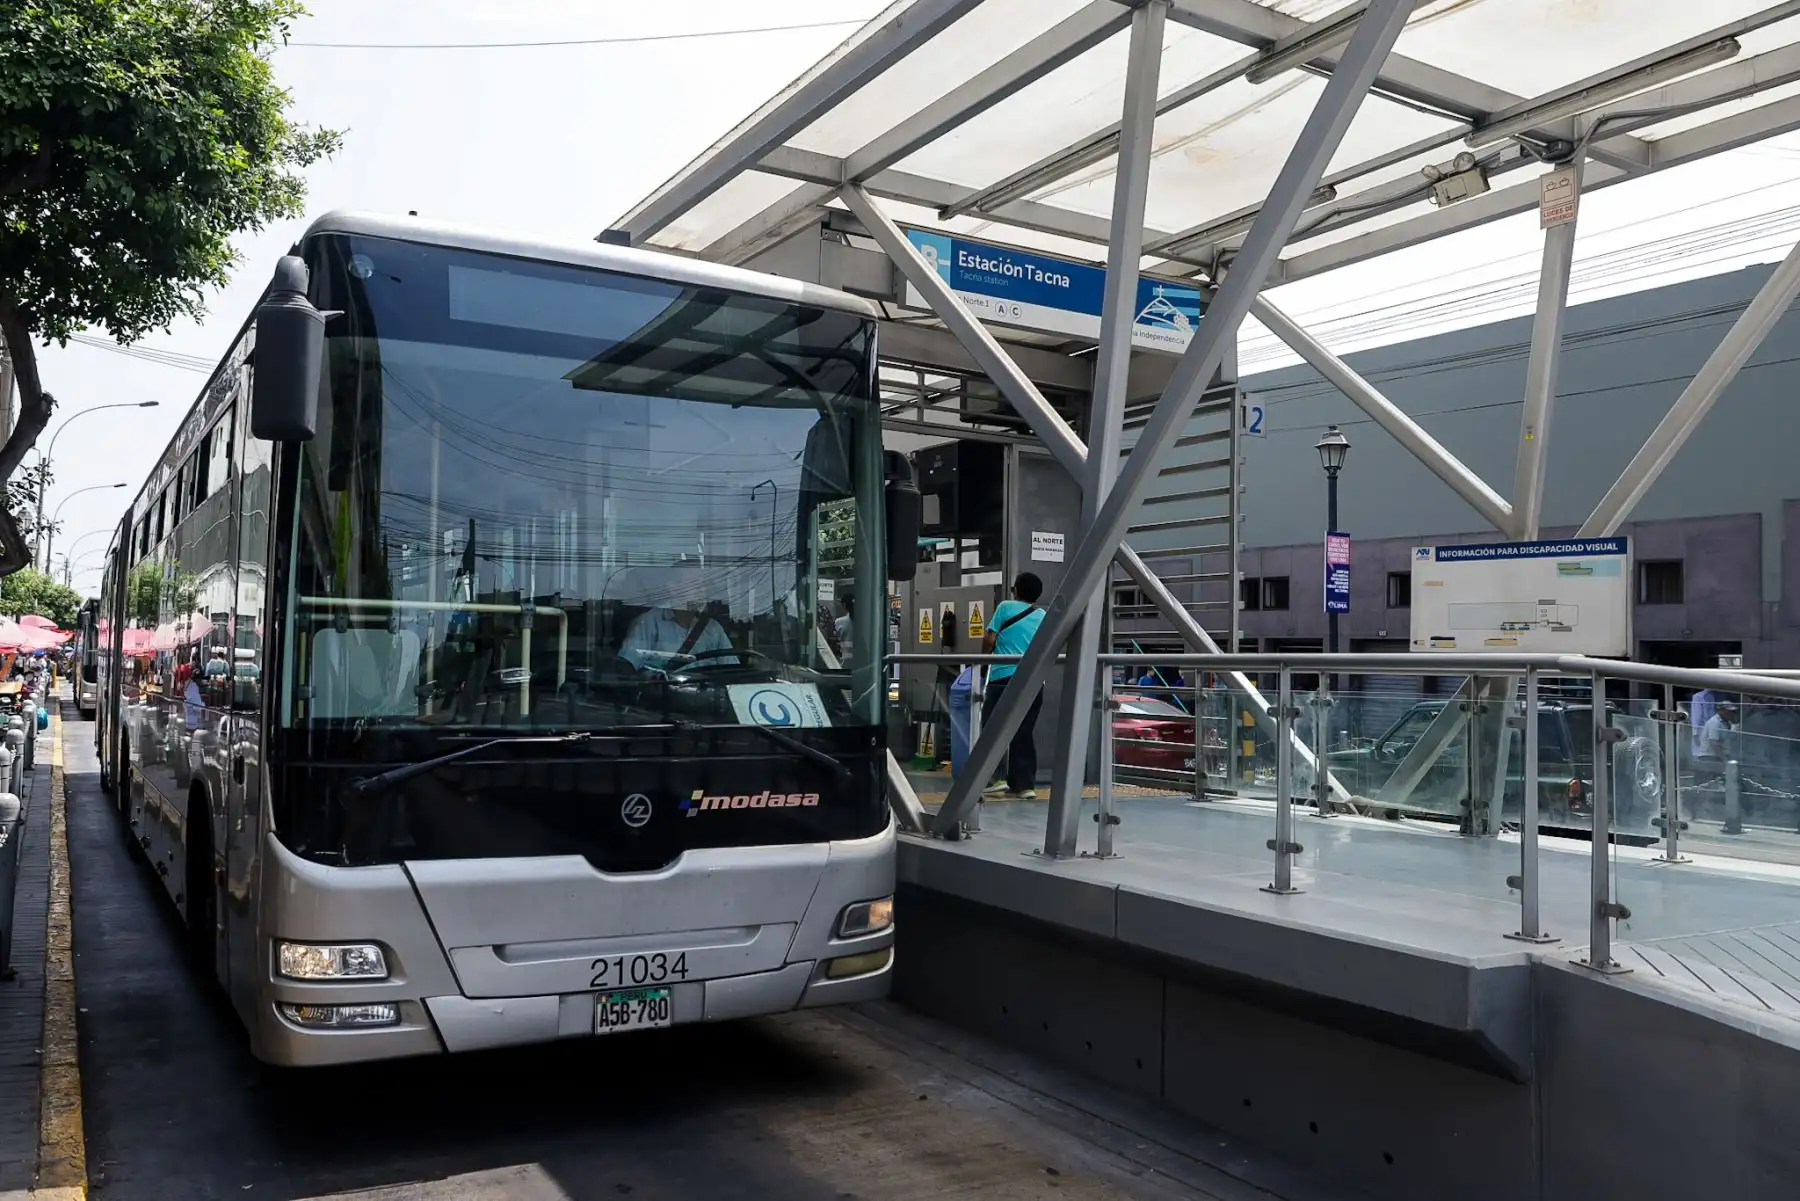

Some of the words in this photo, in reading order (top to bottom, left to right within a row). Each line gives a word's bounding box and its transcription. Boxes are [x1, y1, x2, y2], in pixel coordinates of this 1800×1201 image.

[1543, 207, 1563, 218] LUCES
[958, 249, 1023, 279] Estación
[1025, 264, 1071, 288] Tacna
[959, 270, 983, 283] Tacna
[983, 275, 1009, 287] station
[963, 295, 985, 307] Norte
[1139, 330, 1185, 345] Independencia
[1249, 406, 1263, 434] 2
[1043, 537, 1064, 545] NORTE
[1439, 547, 1496, 559] INFORMACIÓN
[1497, 547, 1519, 556] PARA
[1519, 544, 1585, 555] DISCAPACIDAD
[1585, 542, 1619, 552] VISUAL
[700, 791, 820, 810] modasa
[589, 952, 689, 988] 21034
[599, 997, 669, 1028] A5B-780
